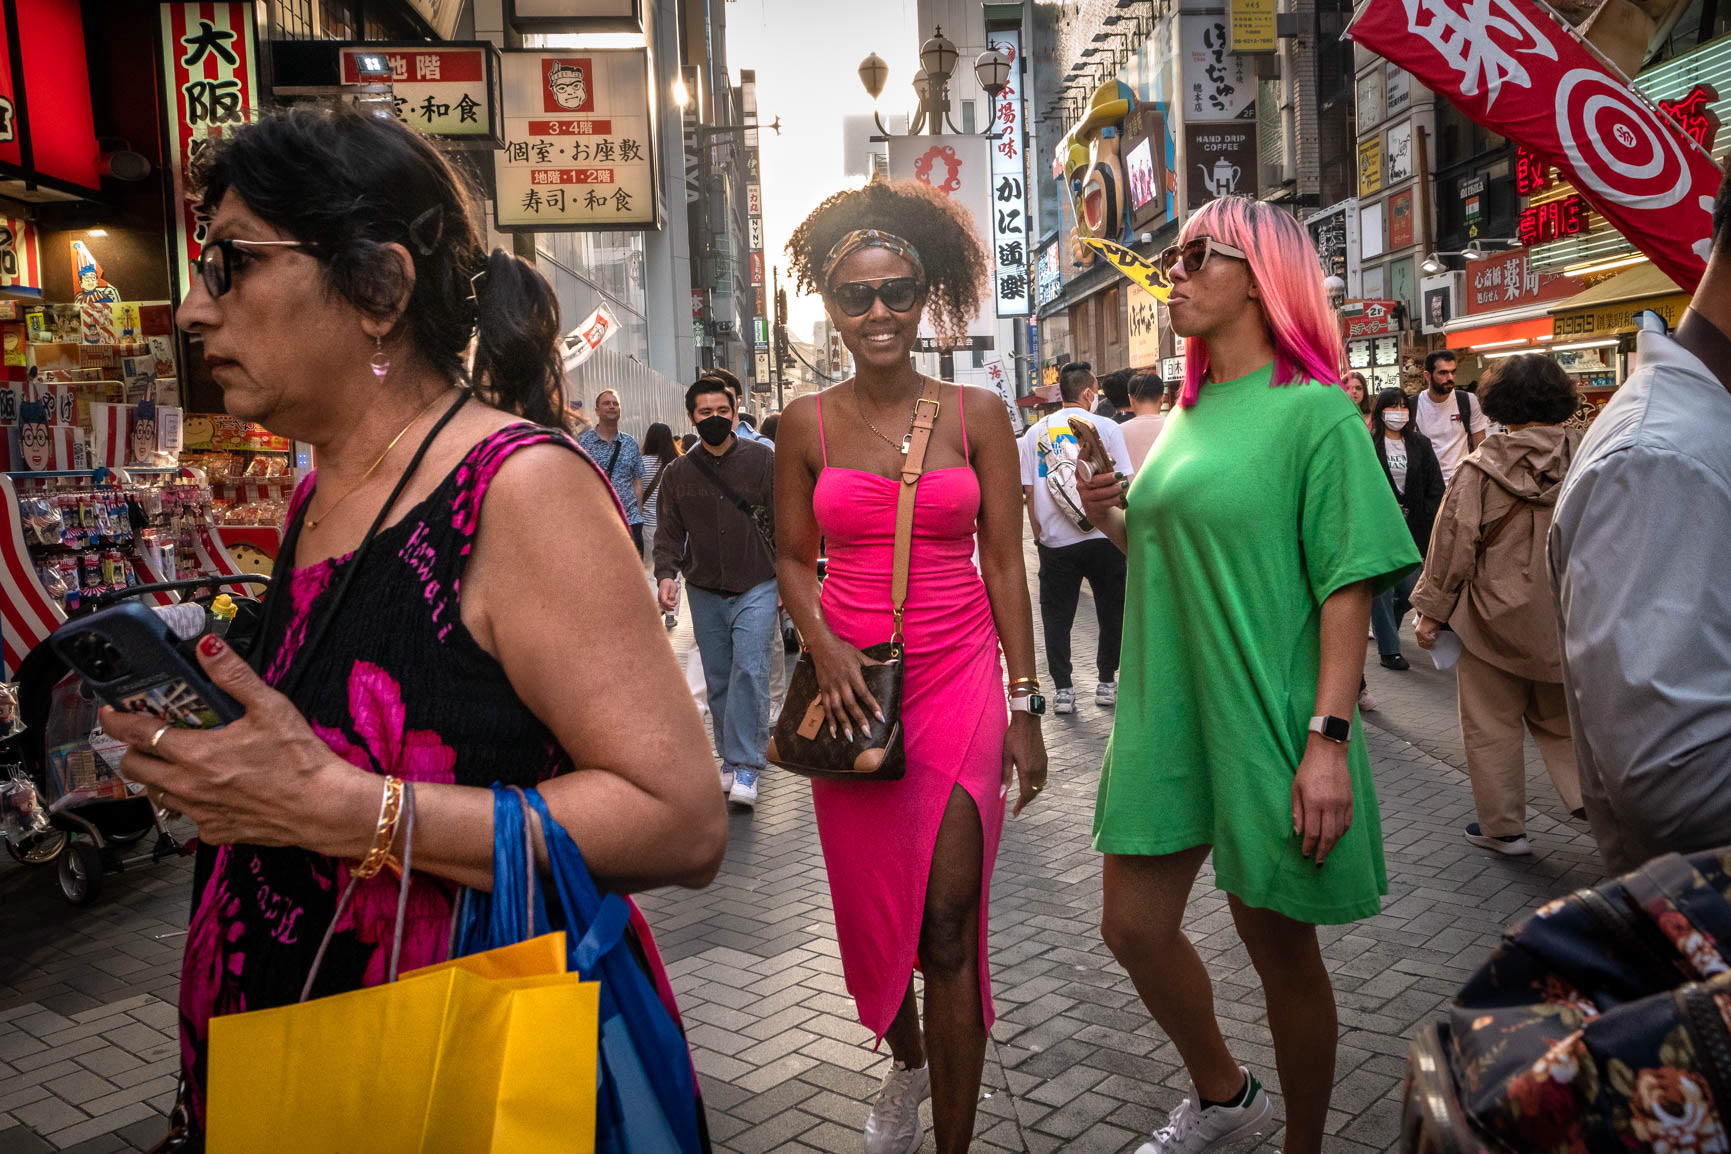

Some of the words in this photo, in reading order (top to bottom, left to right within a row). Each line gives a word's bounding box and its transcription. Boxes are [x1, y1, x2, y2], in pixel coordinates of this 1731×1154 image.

[387, 55, 441, 80] 地階
[997, 80, 1018, 160] 本場の味
[1243, 110, 1255, 118] 2F
[549, 121, 593, 135] 3・4階
[504, 138, 645, 164] 個室・お座敷
[1204, 143, 1239, 151] COFFEE
[534, 170, 612, 184] 地階・1・2階
[521, 187, 633, 214] 寿司・和食
[1474, 266, 1502, 289] 心斎橋
[1503, 256, 1540, 301] 薬局
[1350, 321, 1387, 336] ミティラー
